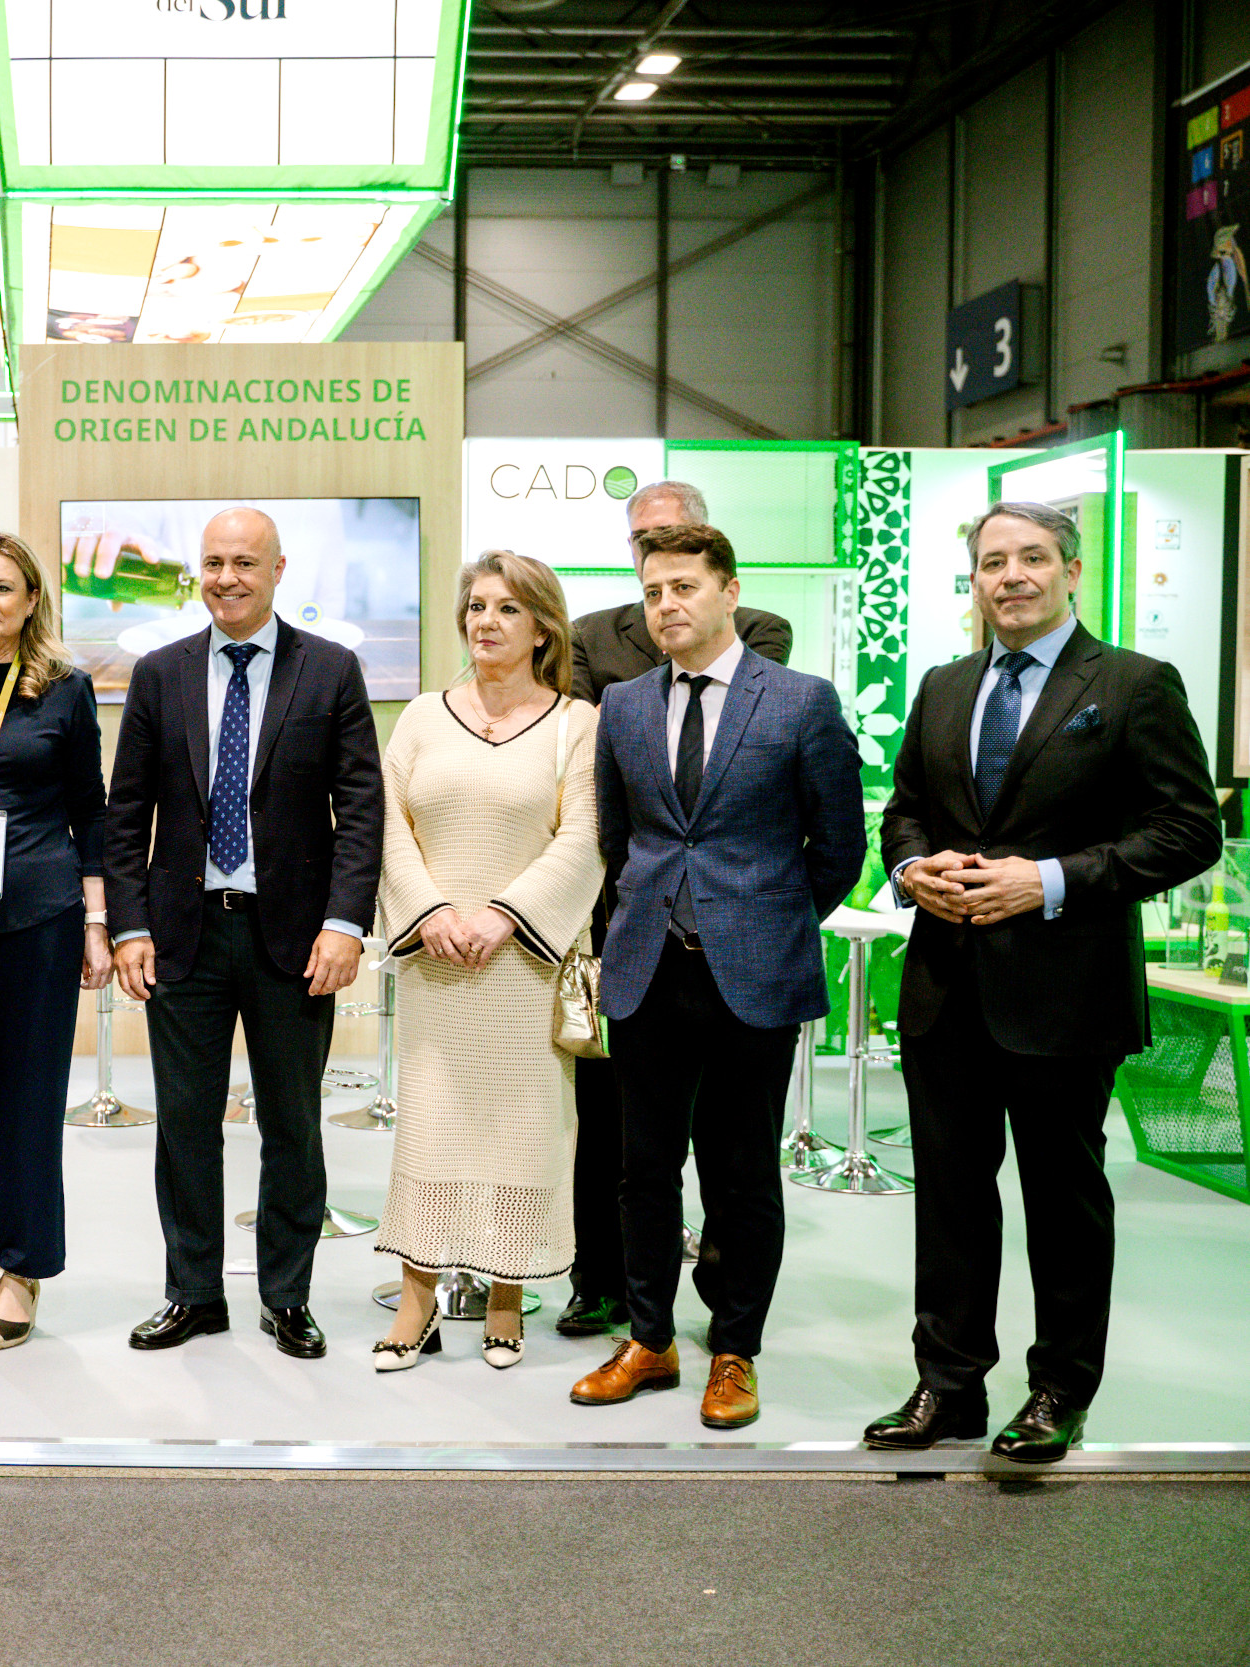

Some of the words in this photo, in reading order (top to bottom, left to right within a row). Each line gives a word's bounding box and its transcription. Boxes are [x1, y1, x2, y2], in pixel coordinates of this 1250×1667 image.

[992, 316, 1012, 378] 3
[61, 379, 361, 404] DENOMINACIONES
[372, 379, 411, 404] DE
[54, 418, 177, 442] ORIGEN
[189, 418, 227, 442] DE
[238, 411, 427, 442] ANDALUCÍA
